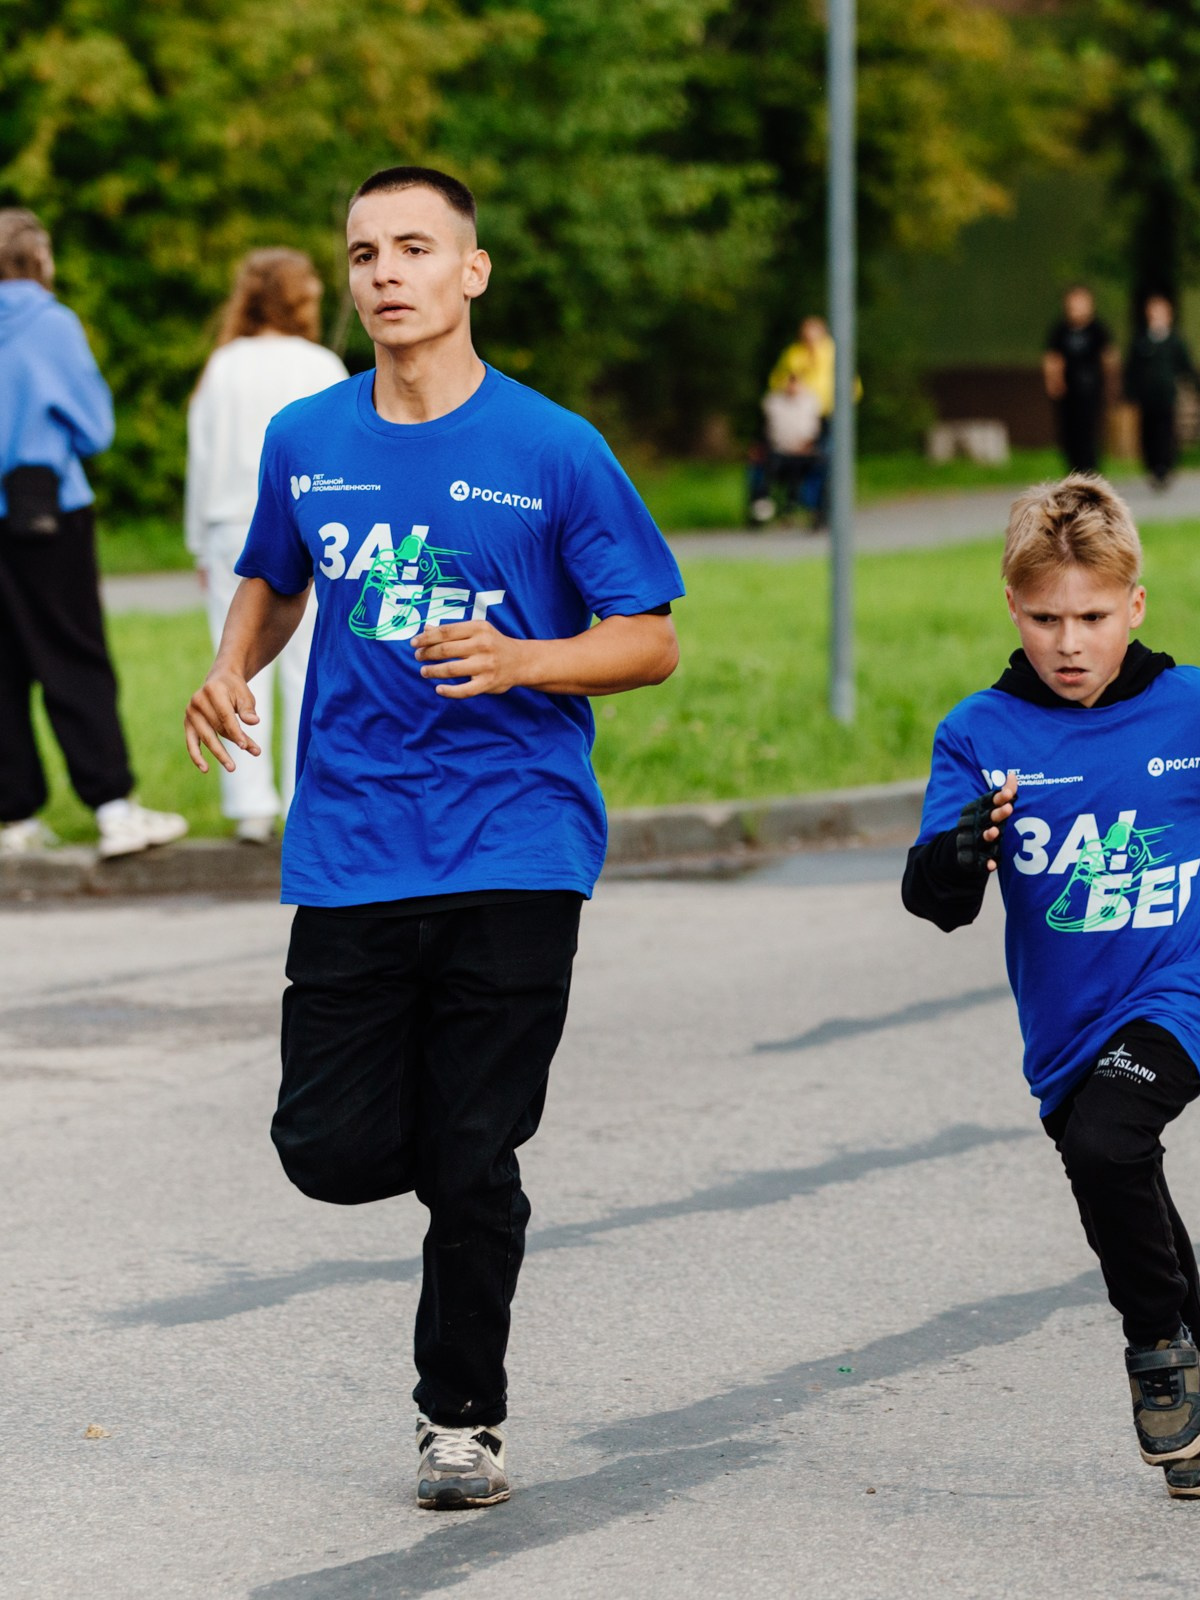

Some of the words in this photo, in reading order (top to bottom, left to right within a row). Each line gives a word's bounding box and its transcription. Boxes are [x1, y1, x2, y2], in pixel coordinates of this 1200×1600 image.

[312, 477, 344, 486] АТОМНОЙ
[312, 484, 381, 492] ПРОМЫШЛЕННОСТИ
[471, 487, 543, 510] РОСАТОМ
[318, 522, 430, 580] ЗА!
[1017, 776, 1083, 786] ОМЫШЛЕННОСТИ
[1013, 809, 1137, 876] ЗА!
[1113, 1057, 1157, 1082] ISLAND
